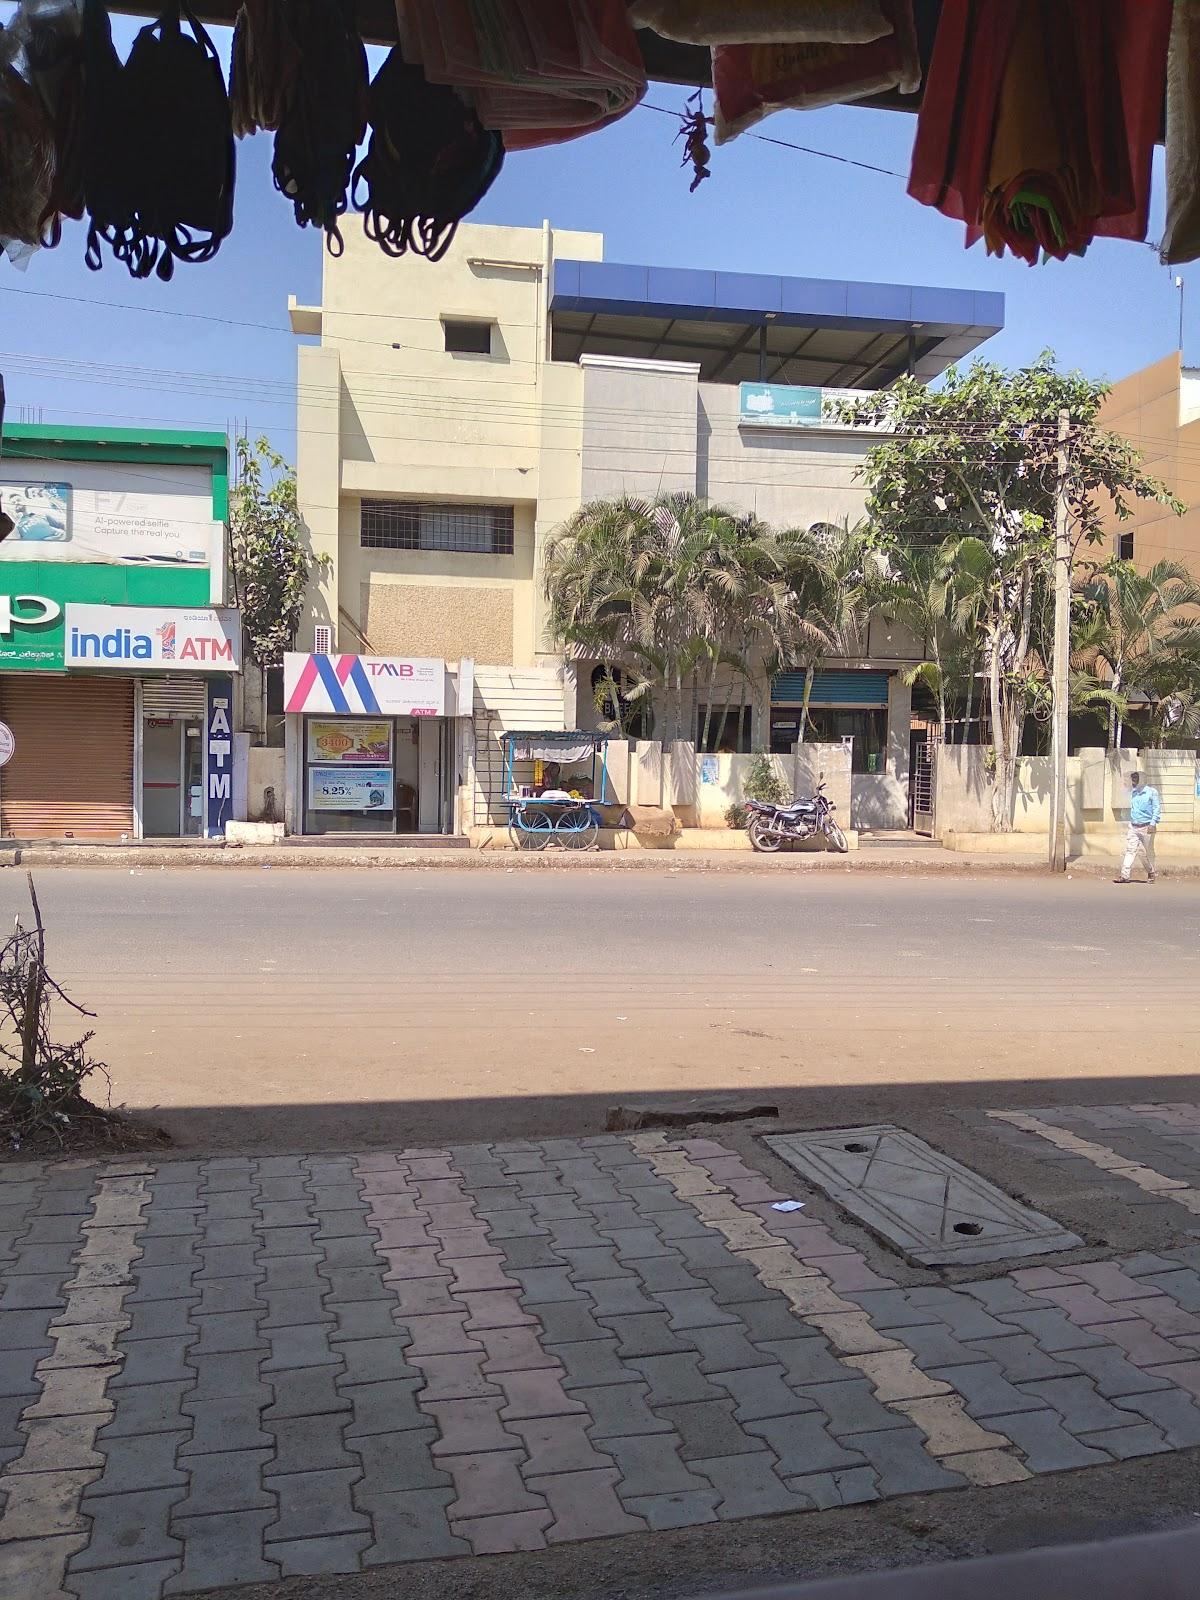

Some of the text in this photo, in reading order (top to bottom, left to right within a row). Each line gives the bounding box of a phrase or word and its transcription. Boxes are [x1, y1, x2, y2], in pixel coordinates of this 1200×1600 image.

[148, 519, 169, 528] selfie
[94, 527, 129, 536] Capture
[165, 531, 180, 539] you
[71, 627, 153, 660] india
[180, 637, 233, 661] ATM
[367, 663, 414, 677] TMB
[209, 708, 231, 799] ATM
[322, 786, 352, 796] 8.25%
